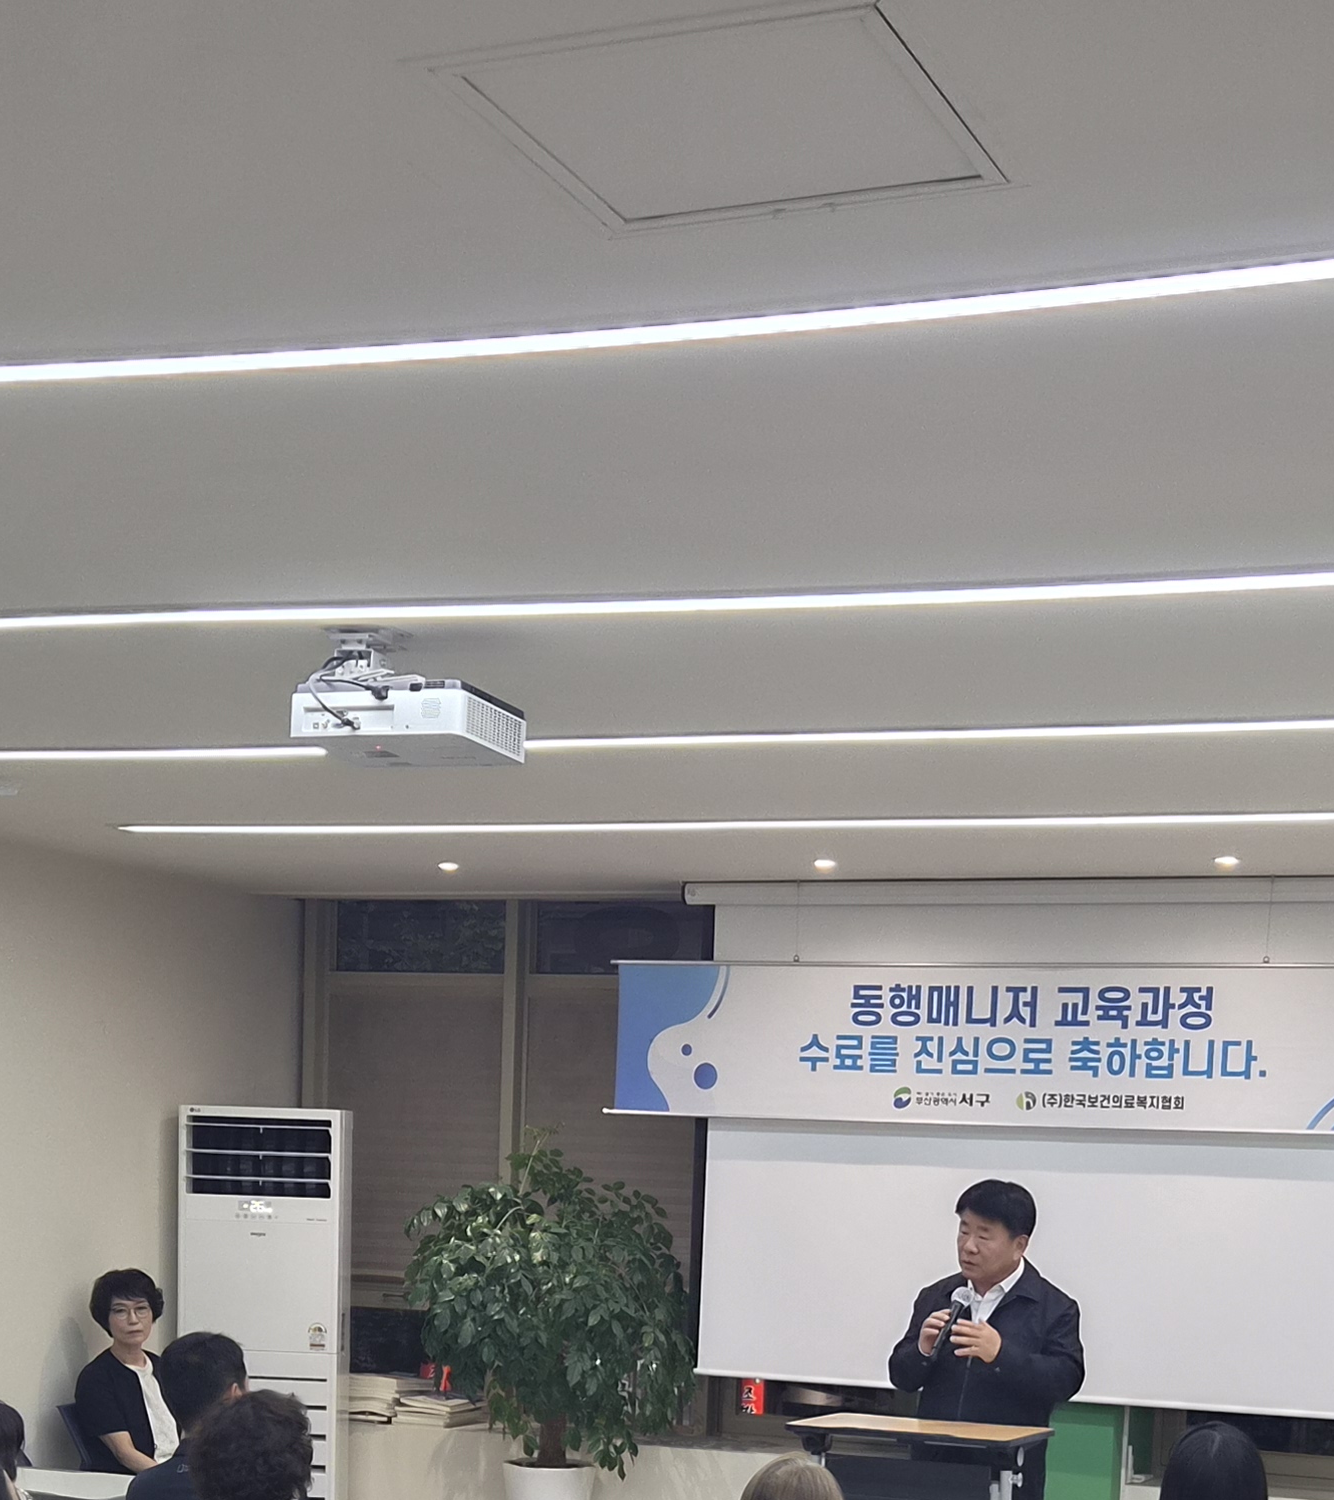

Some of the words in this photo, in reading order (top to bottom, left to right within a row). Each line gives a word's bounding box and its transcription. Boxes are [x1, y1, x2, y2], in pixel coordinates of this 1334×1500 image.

[849, 982, 1039, 1029] 동행매니저
[1053, 985, 1215, 1031] 교육과정
[798, 1033, 900, 1073] 수료를
[913, 1035, 1054, 1076] 진심으로
[1067, 1036, 1267, 1080] 축하합니다.
[958, 1092, 991, 1108] 서구
[1041, 1092, 1185, 1111] (주)한국보건의료복지협회
